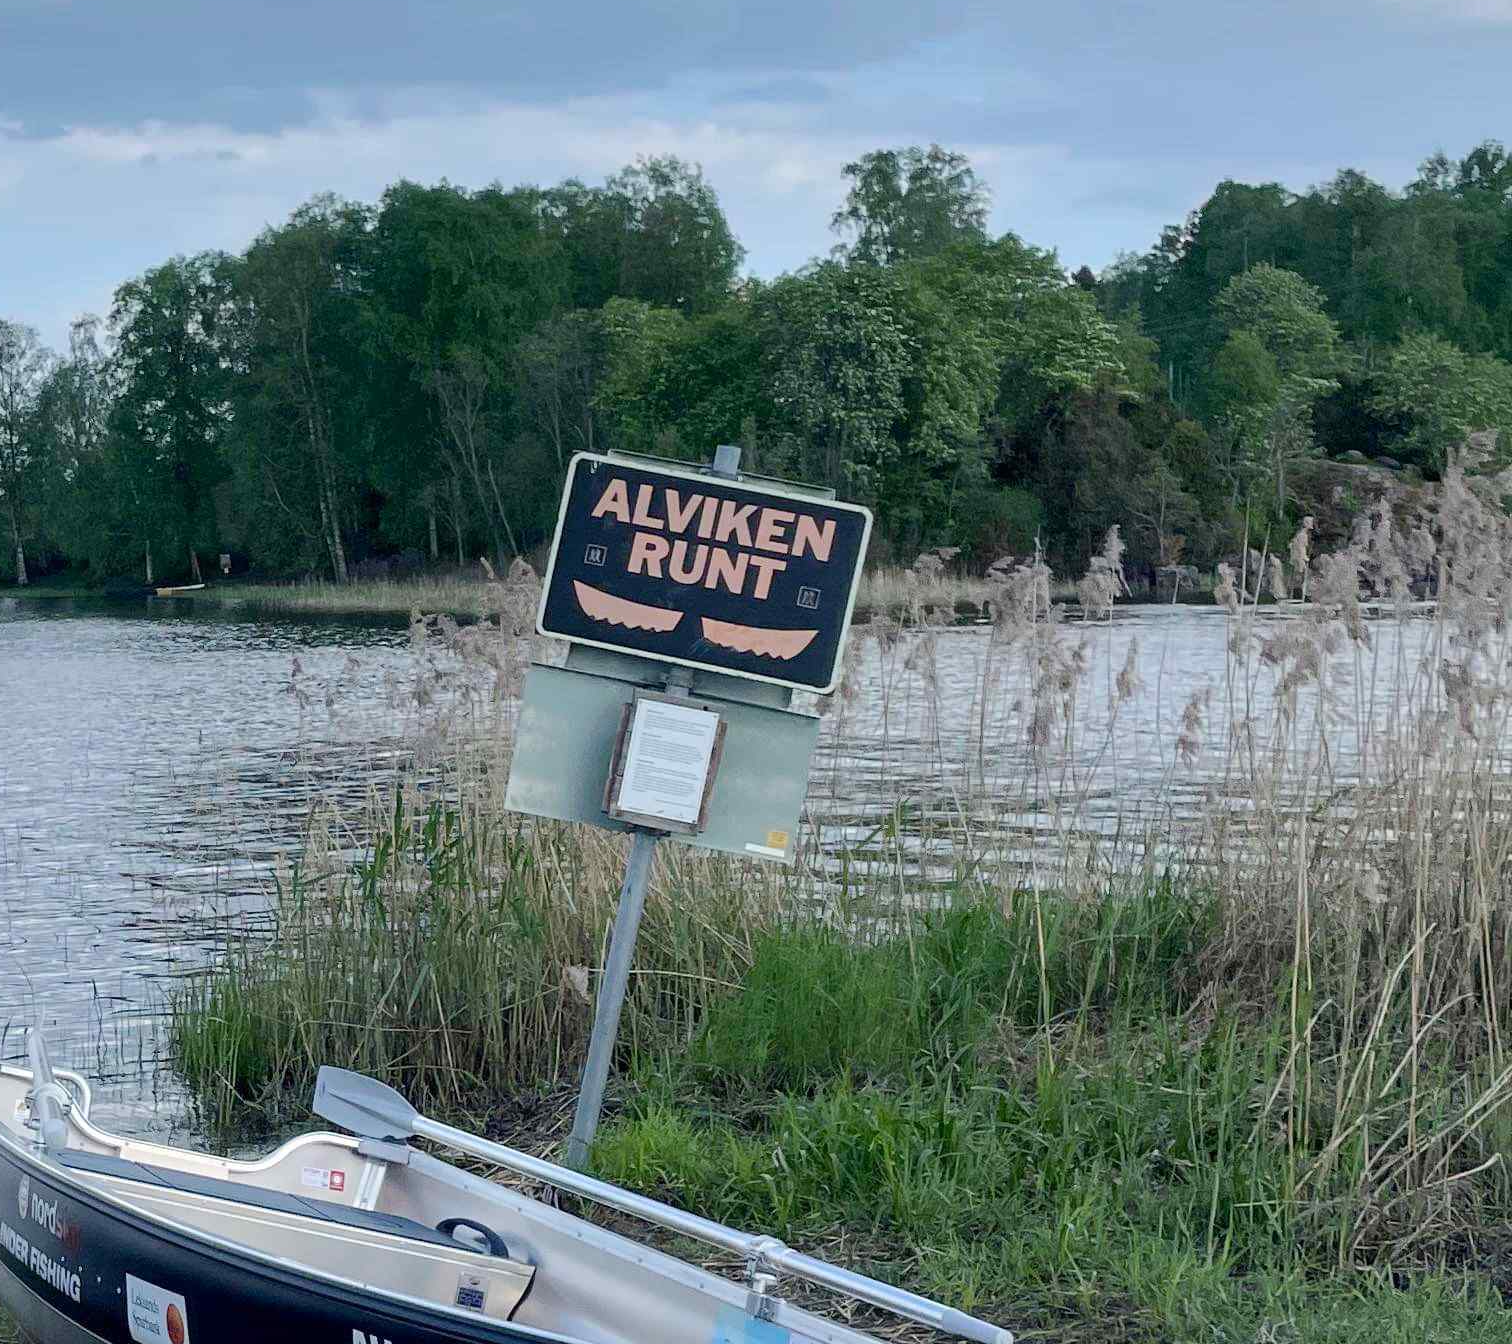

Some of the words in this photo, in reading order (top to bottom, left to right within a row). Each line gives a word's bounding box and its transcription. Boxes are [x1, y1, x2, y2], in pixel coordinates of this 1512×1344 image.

[592, 479, 836, 562] ALVIKEN
[627, 532, 787, 599] RUNT
[31, 1247, 81, 1303] FISHING
